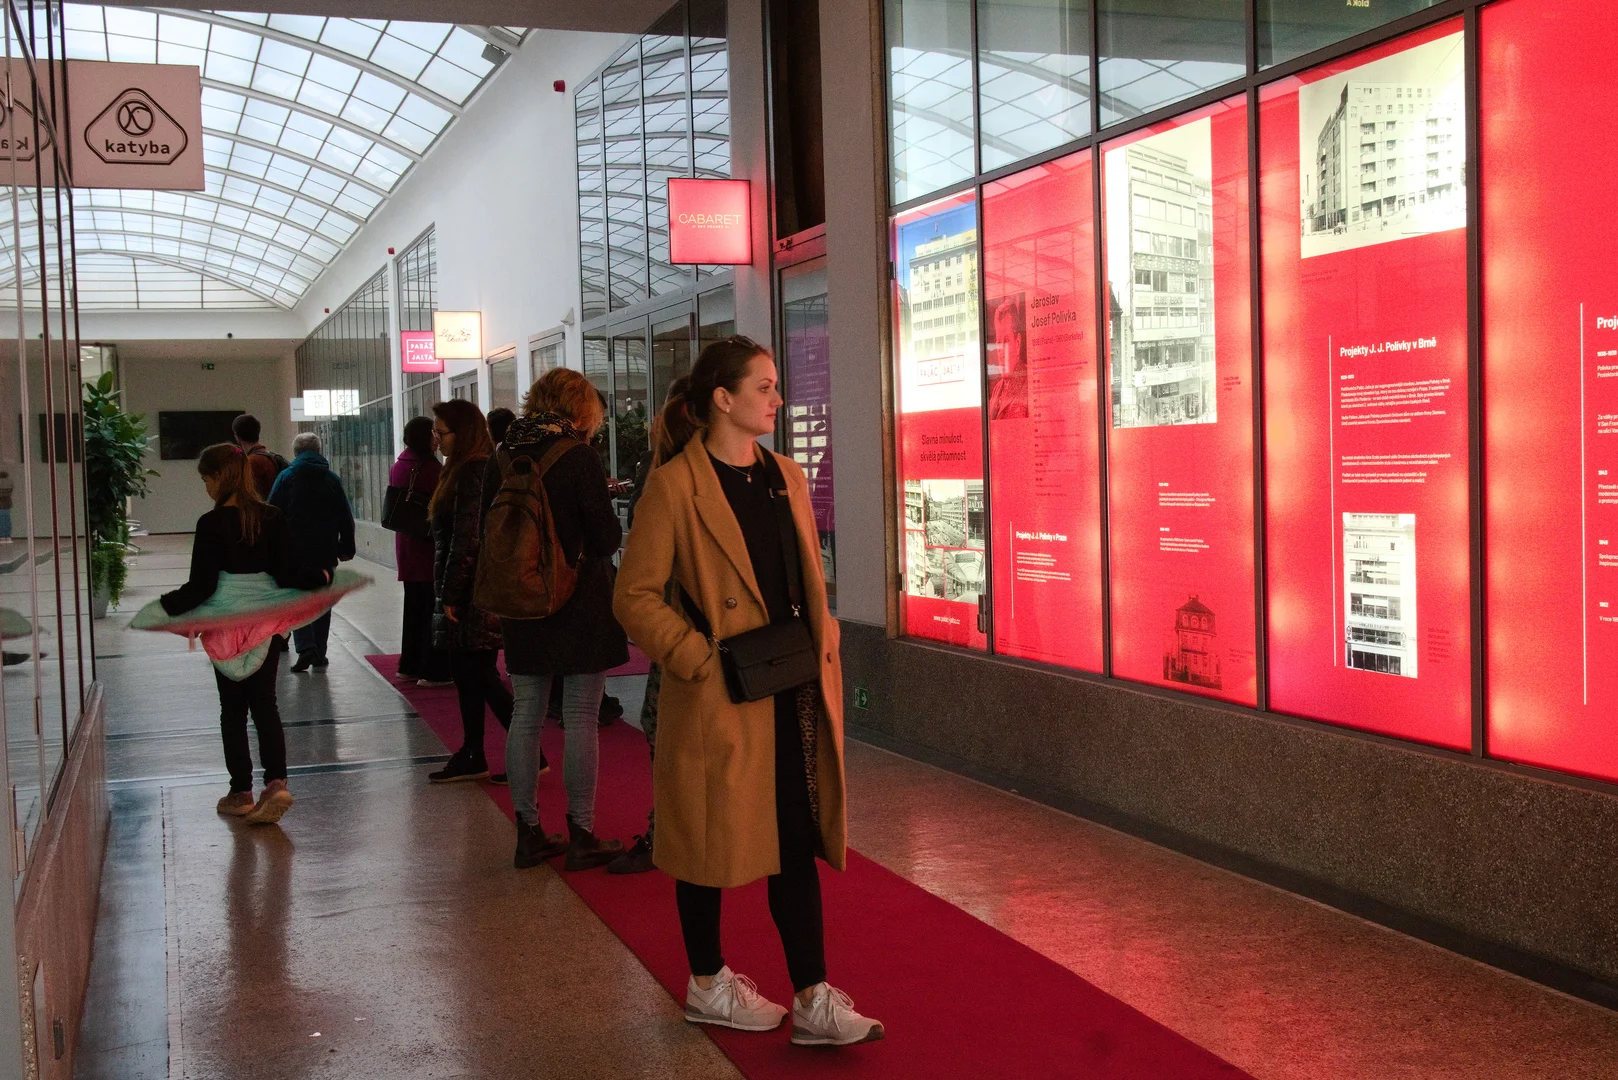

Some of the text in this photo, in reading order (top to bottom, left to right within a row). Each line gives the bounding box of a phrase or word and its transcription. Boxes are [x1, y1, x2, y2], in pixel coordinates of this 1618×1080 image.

[105, 138, 171, 156] katyba
[678, 213, 743, 225] CABARET
[1031, 293, 1060, 309] Jaroslav
[1031, 312, 1051, 328] Josef
[1340, 337, 1437, 358] Projekty J. J. Polívky v Brně
[921, 433, 938, 445] Slavná
